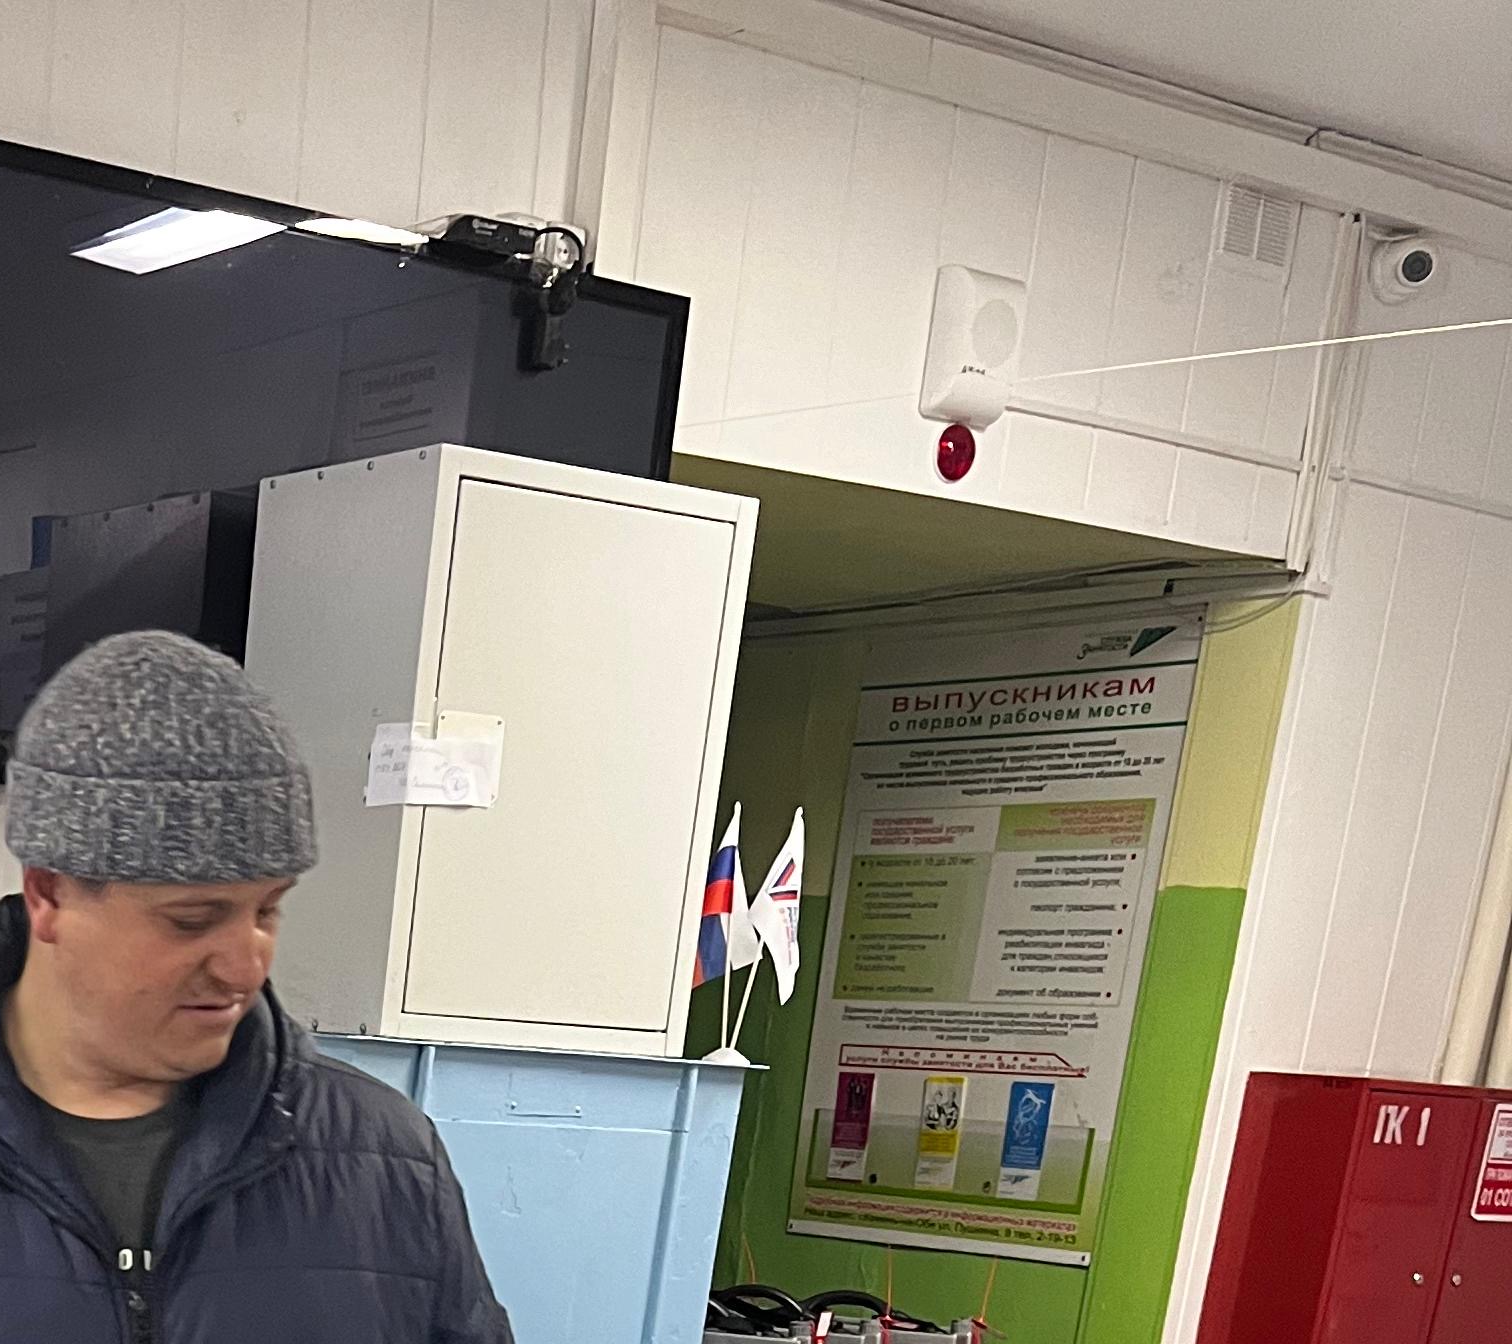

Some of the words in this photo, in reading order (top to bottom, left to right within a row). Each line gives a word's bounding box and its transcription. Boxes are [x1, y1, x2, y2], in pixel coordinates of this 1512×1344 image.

[891, 676, 1156, 714] выпускникам
[889, 720, 900, 732] о
[906, 714, 983, 733] первом
[990, 705, 1080, 729] рабочем
[1088, 702, 1152, 718] месте
